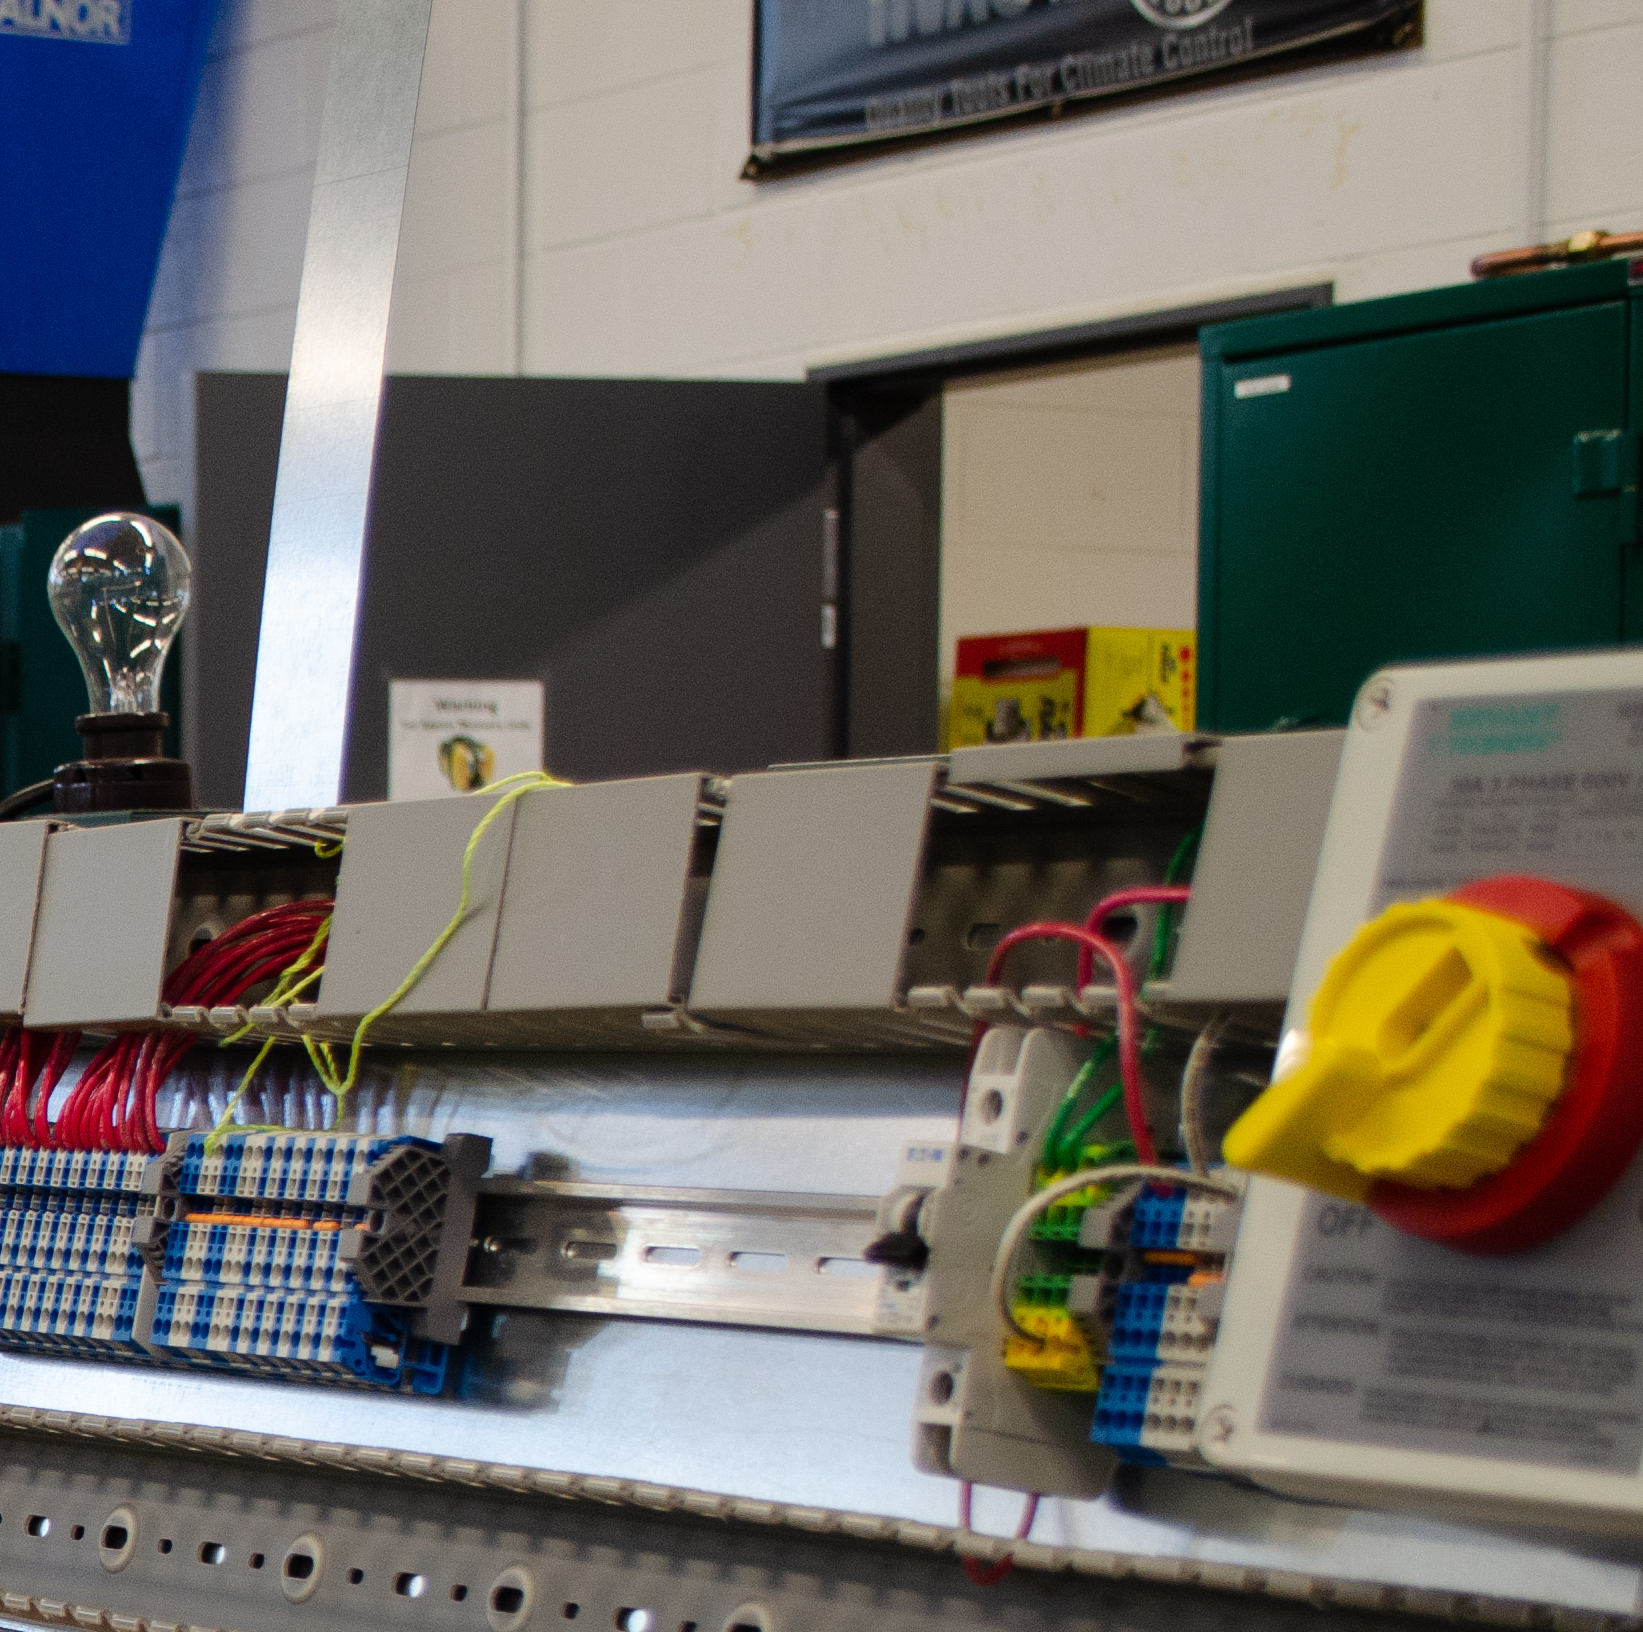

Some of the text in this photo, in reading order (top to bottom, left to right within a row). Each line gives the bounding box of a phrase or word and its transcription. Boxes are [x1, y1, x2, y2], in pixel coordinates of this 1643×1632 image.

[1016, 62, 1056, 100] For
[1060, 41, 1154, 92] Climate
[1161, 17, 1255, 70] Control
